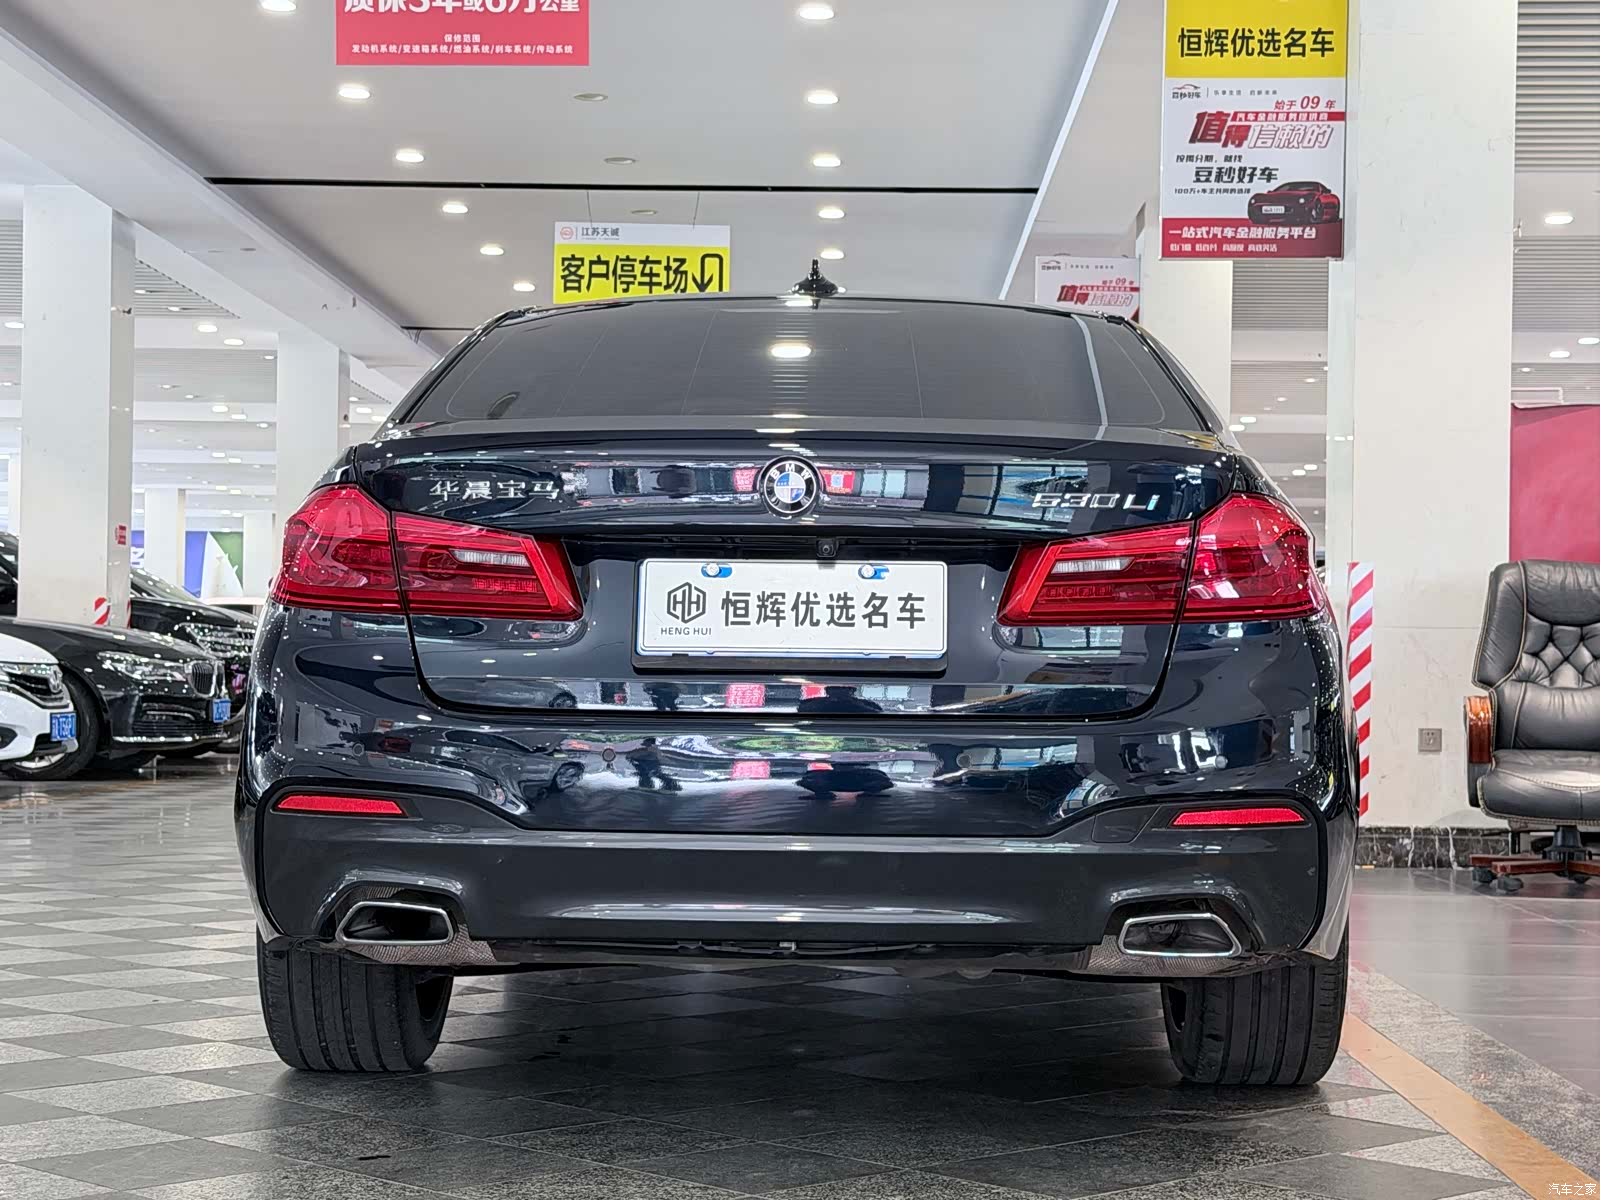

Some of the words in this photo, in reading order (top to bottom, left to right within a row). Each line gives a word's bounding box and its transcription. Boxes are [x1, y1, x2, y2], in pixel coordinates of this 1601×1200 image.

[443, 34, 481, 43] 保修范围
[1178, 27, 1335, 58] 恒辉优选名车
[1274, 100, 1297, 110] 始于
[1300, 96, 1321, 109] 09
[1325, 100, 1337, 110] 年
[1189, 111, 1334, 149] 值得信赖的
[1193, 166, 1280, 184] 豆秒好车
[1169, 226, 1317, 240] 一站式汽车金融服务平台
[560, 254, 689, 295] 客户停车场
[770, 463, 812, 480] BMW
[429, 480, 560, 501] 华晨宝马
[720, 590, 926, 630] 恒辉优选名车
[660, 627, 691, 636] HENG
[693, 627, 712, 636] HUI
